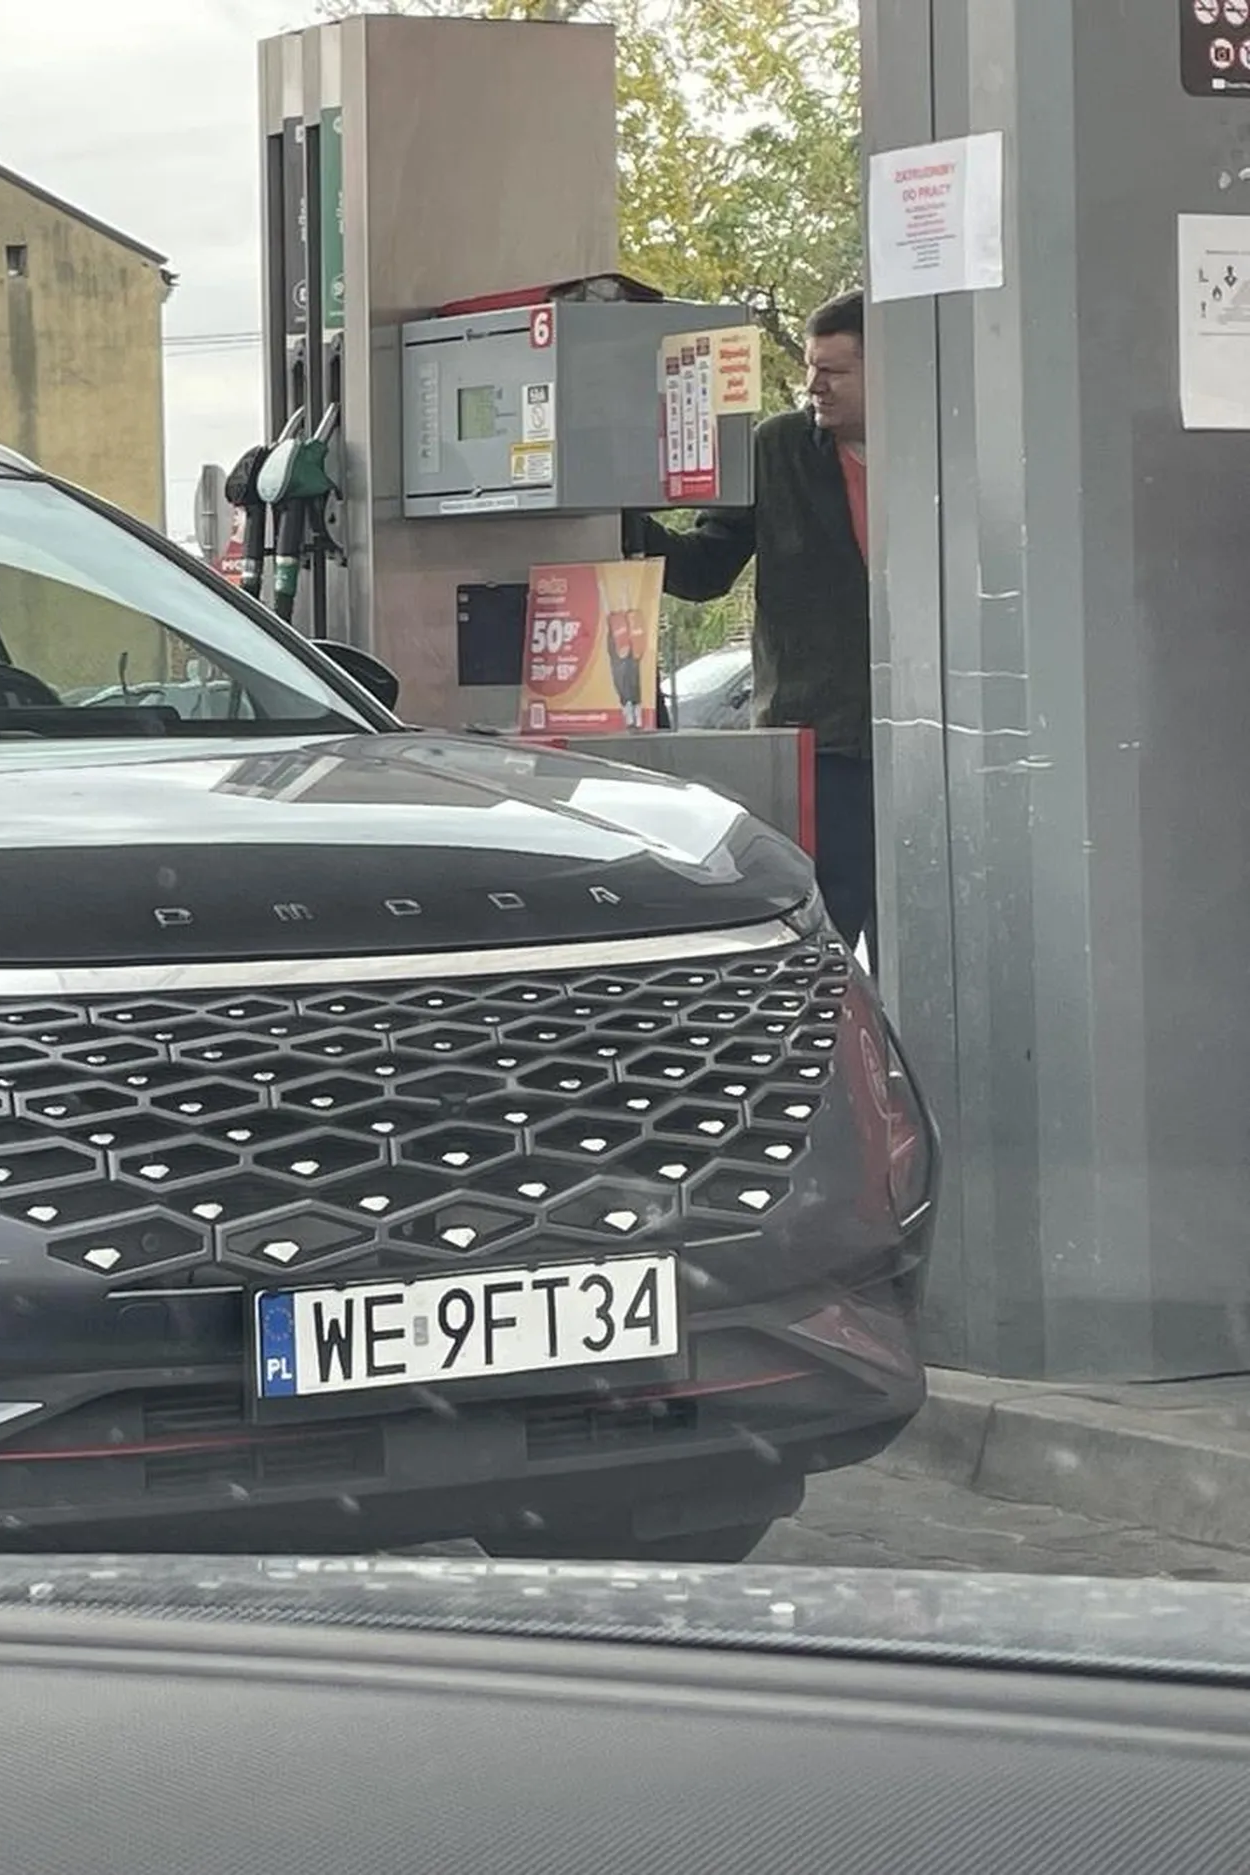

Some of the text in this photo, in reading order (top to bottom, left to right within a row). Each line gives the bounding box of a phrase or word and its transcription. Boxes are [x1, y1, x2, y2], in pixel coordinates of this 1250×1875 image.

[533, 312, 550, 346] 6
[154, 886, 621, 927] OMODA
[313, 1266, 660, 1383] WE 9FT34
[267, 1357, 293, 1381] PL
